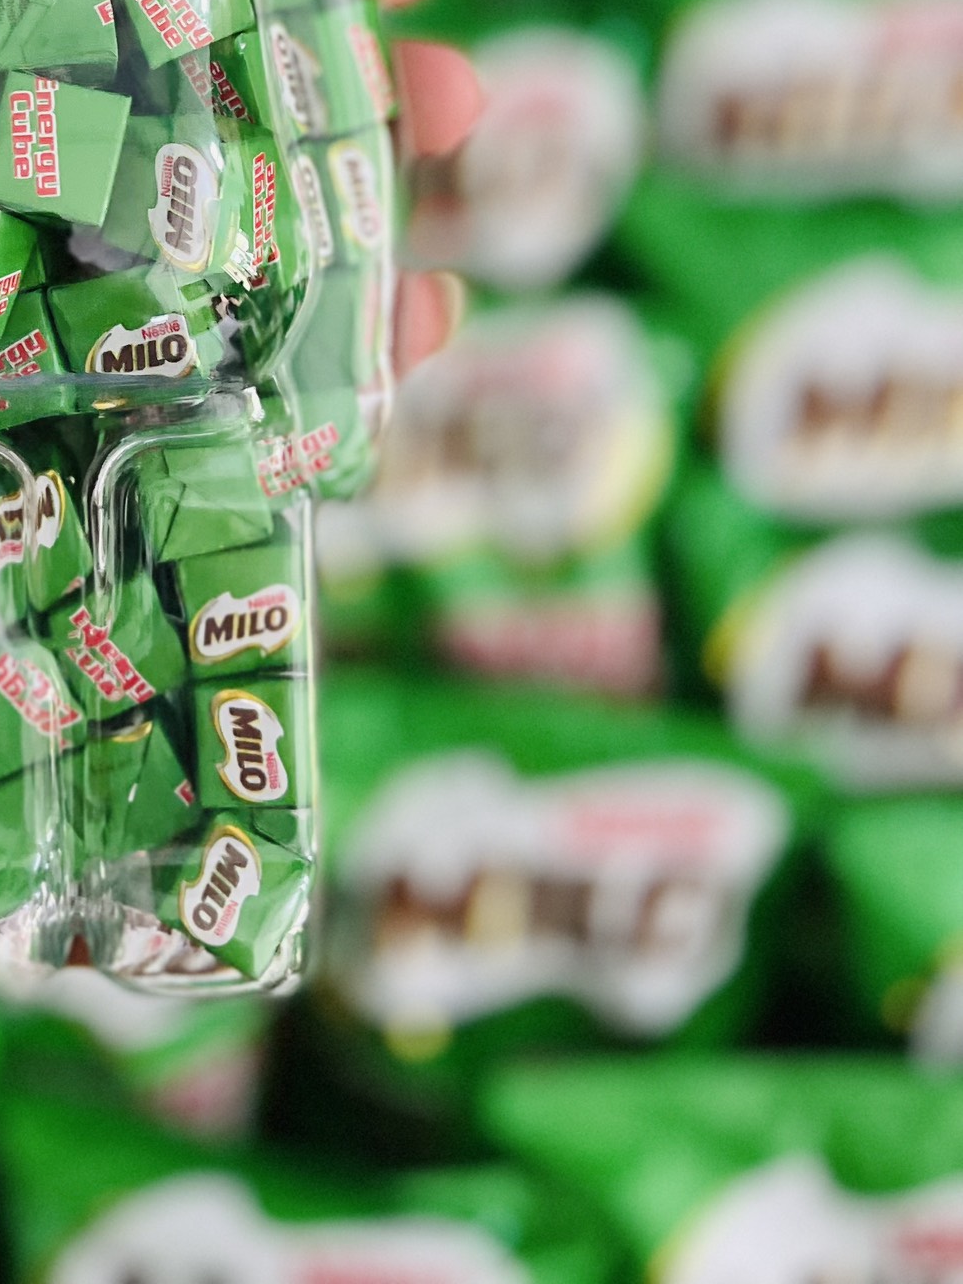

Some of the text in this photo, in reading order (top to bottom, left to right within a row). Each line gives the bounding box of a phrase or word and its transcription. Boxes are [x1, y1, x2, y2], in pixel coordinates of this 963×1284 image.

[9, 90, 37, 180] Cube
[34, 76, 62, 198] Energy
[165, 155, 199, 255] MILO
[101, 333, 189, 374] MILO
[203, 605, 287, 647] MILO
[228, 707, 267, 792] MILO
[192, 842, 248, 932] MILO
